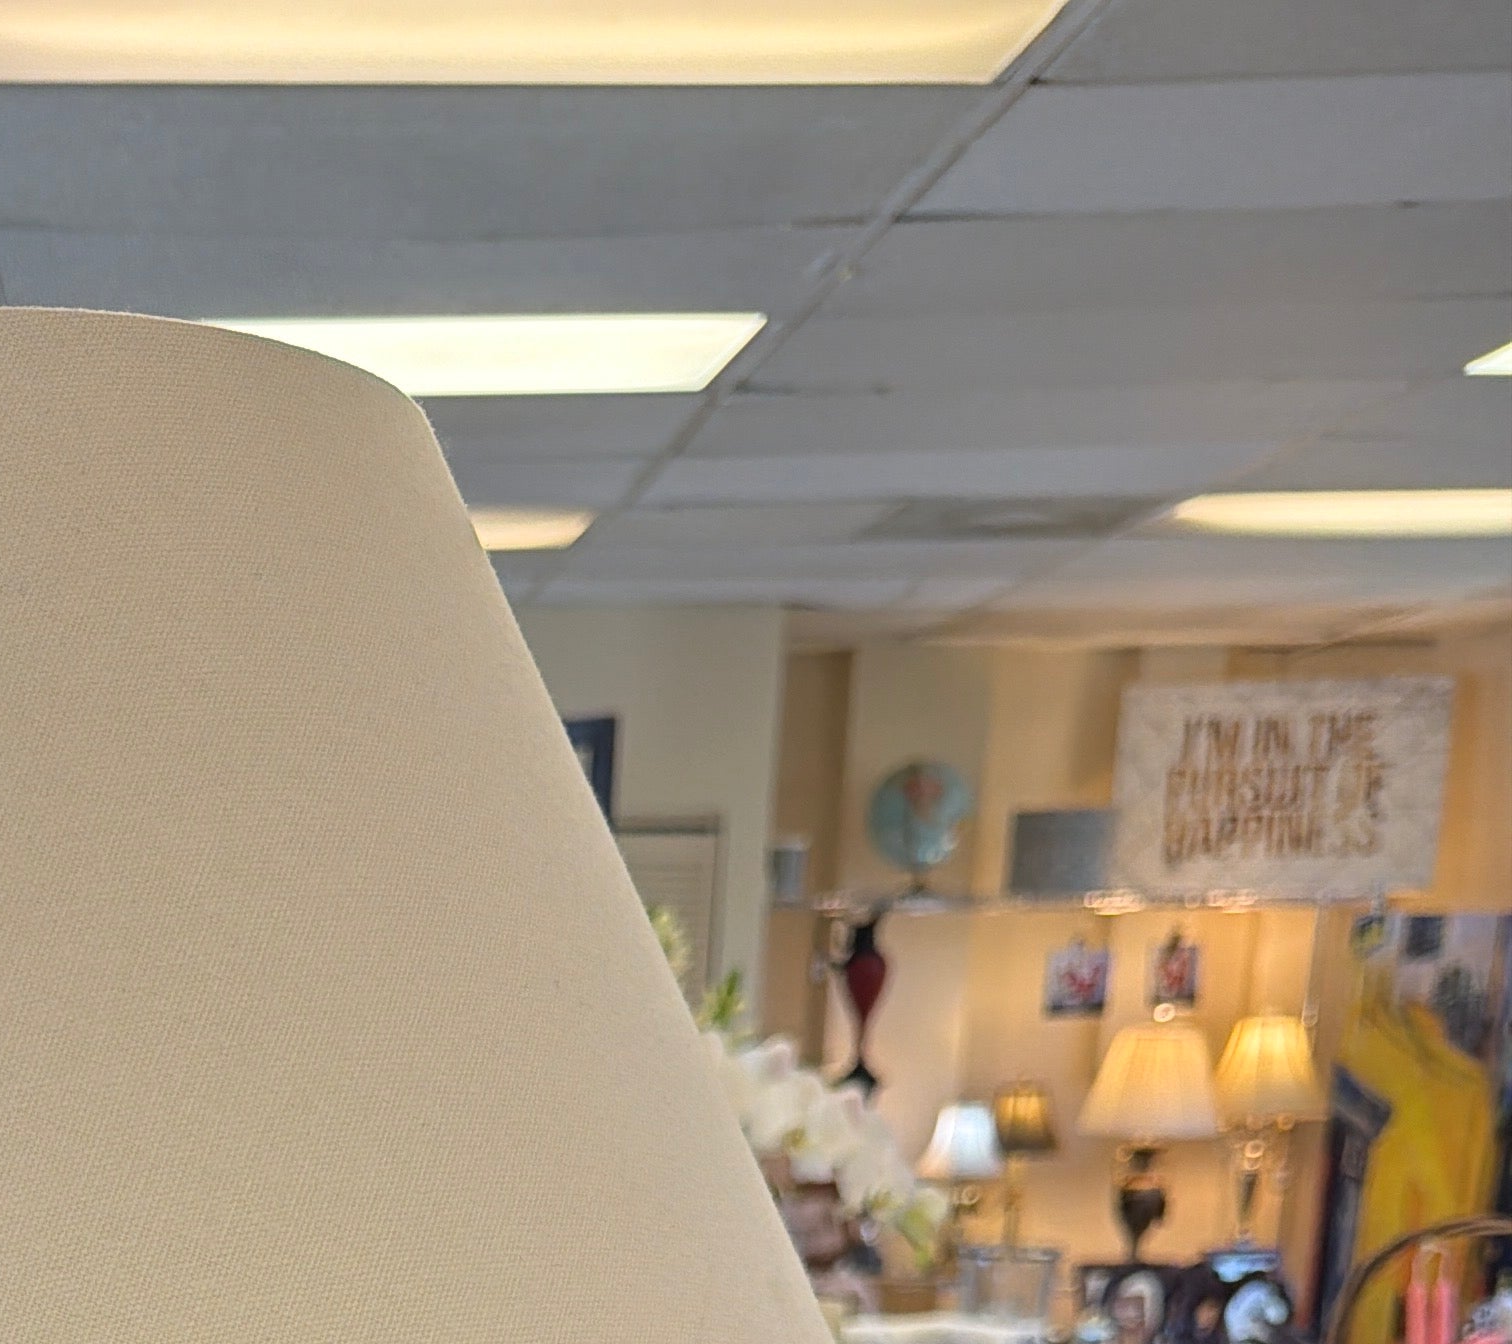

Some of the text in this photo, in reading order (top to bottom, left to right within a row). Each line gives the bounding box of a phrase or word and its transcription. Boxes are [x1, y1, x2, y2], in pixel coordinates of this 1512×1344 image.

[1252, 715, 1291, 758] IN
[1308, 709, 1378, 757] THE
[1164, 764, 1330, 814] PURSUIT
